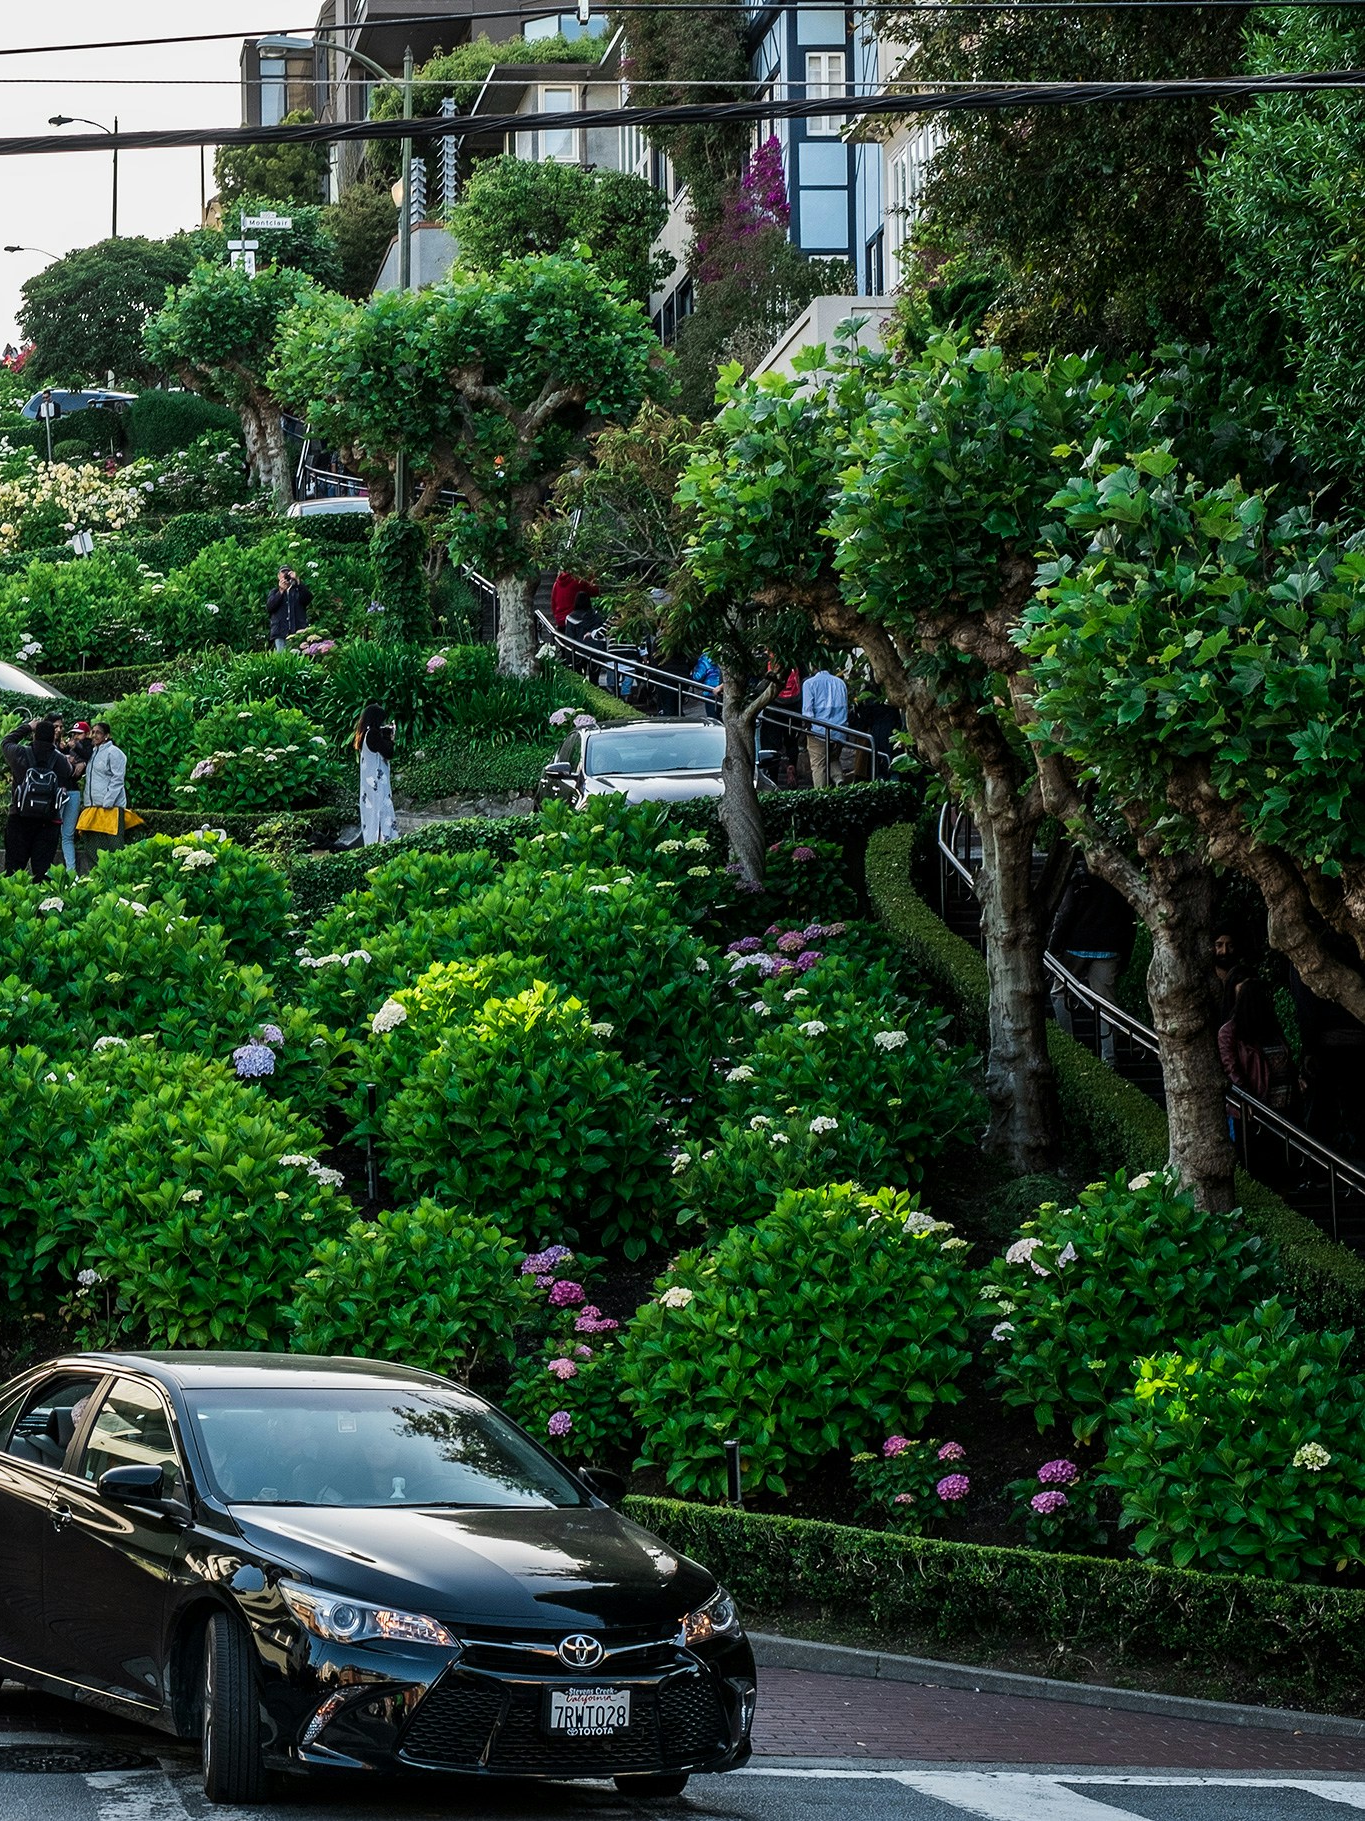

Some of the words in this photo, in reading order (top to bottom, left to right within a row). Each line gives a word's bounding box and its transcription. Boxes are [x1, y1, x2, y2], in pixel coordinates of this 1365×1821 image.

[569, 1687, 594, 1695] Stevens
[595, 1687, 615, 1695] Creek
[566, 1694, 617, 1705] California
[554, 1705, 626, 1728] 7RWT028
[579, 1727, 614, 1736] TOYOTA
